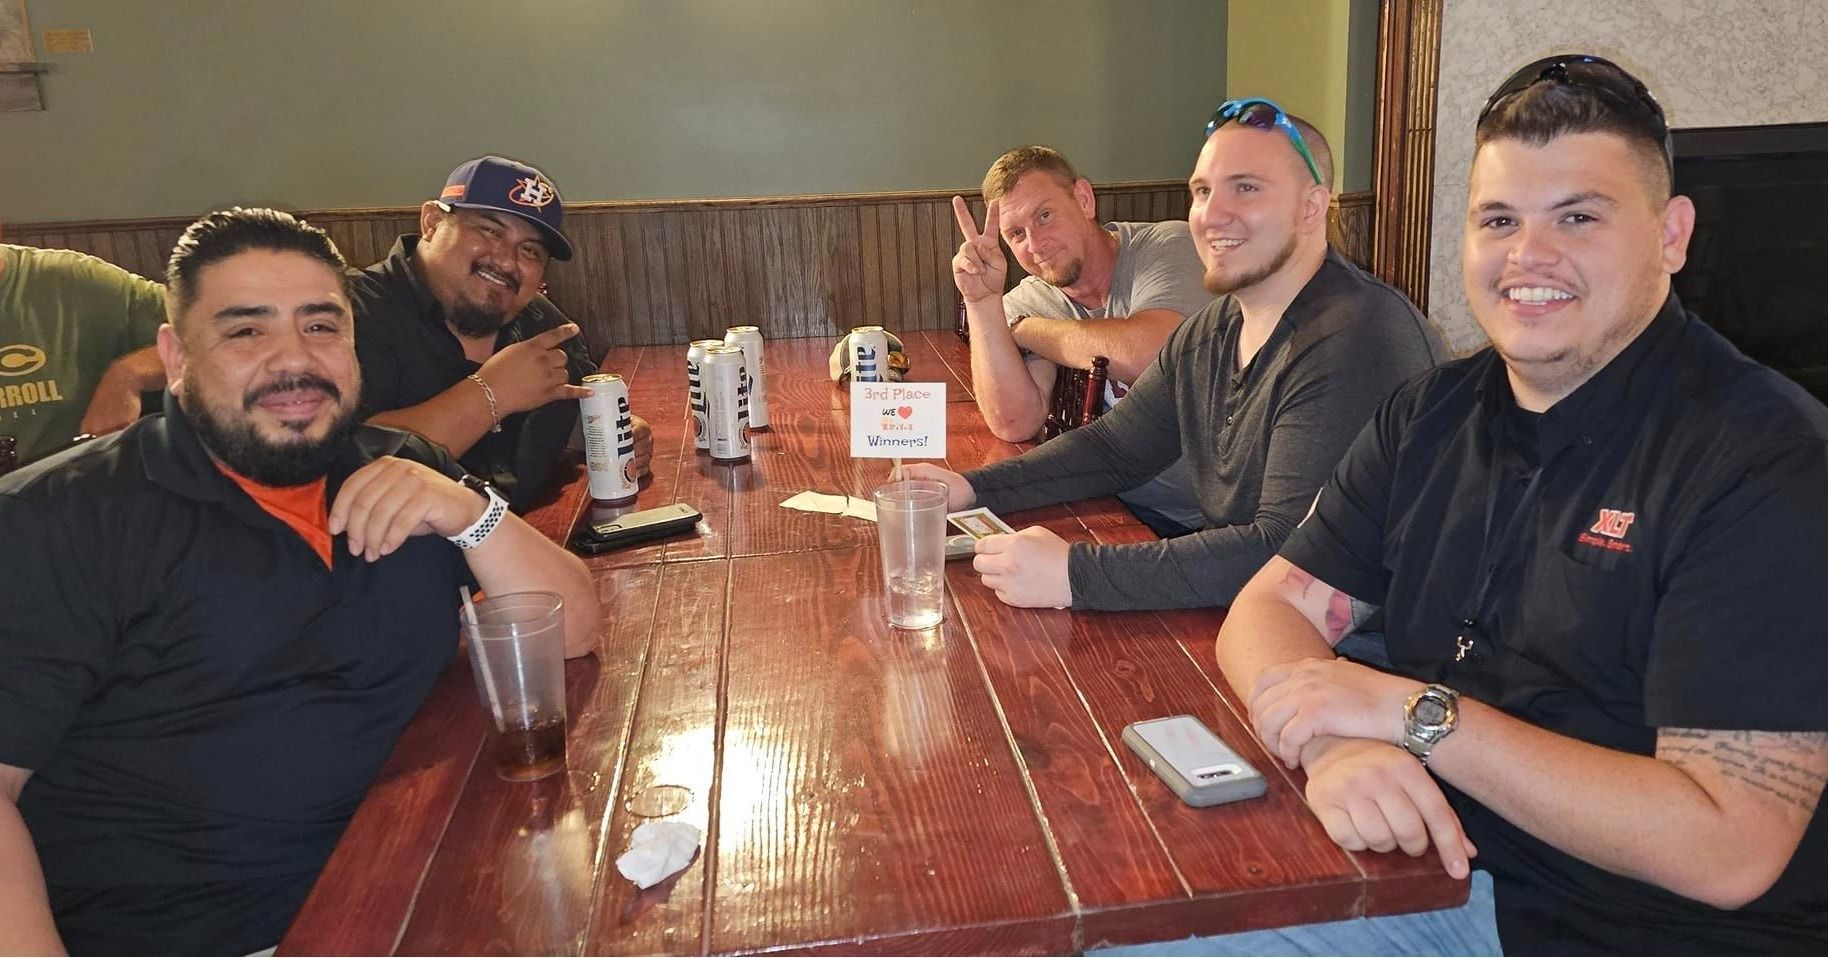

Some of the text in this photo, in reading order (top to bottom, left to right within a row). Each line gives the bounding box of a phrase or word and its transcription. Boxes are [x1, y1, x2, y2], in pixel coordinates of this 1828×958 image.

[864, 387, 931, 400] 3rd Place
[882, 408, 896, 416] WE
[615, 396, 632, 460] lite
[867, 435, 928, 447] Winners!
[1590, 508, 1635, 538] XLT
